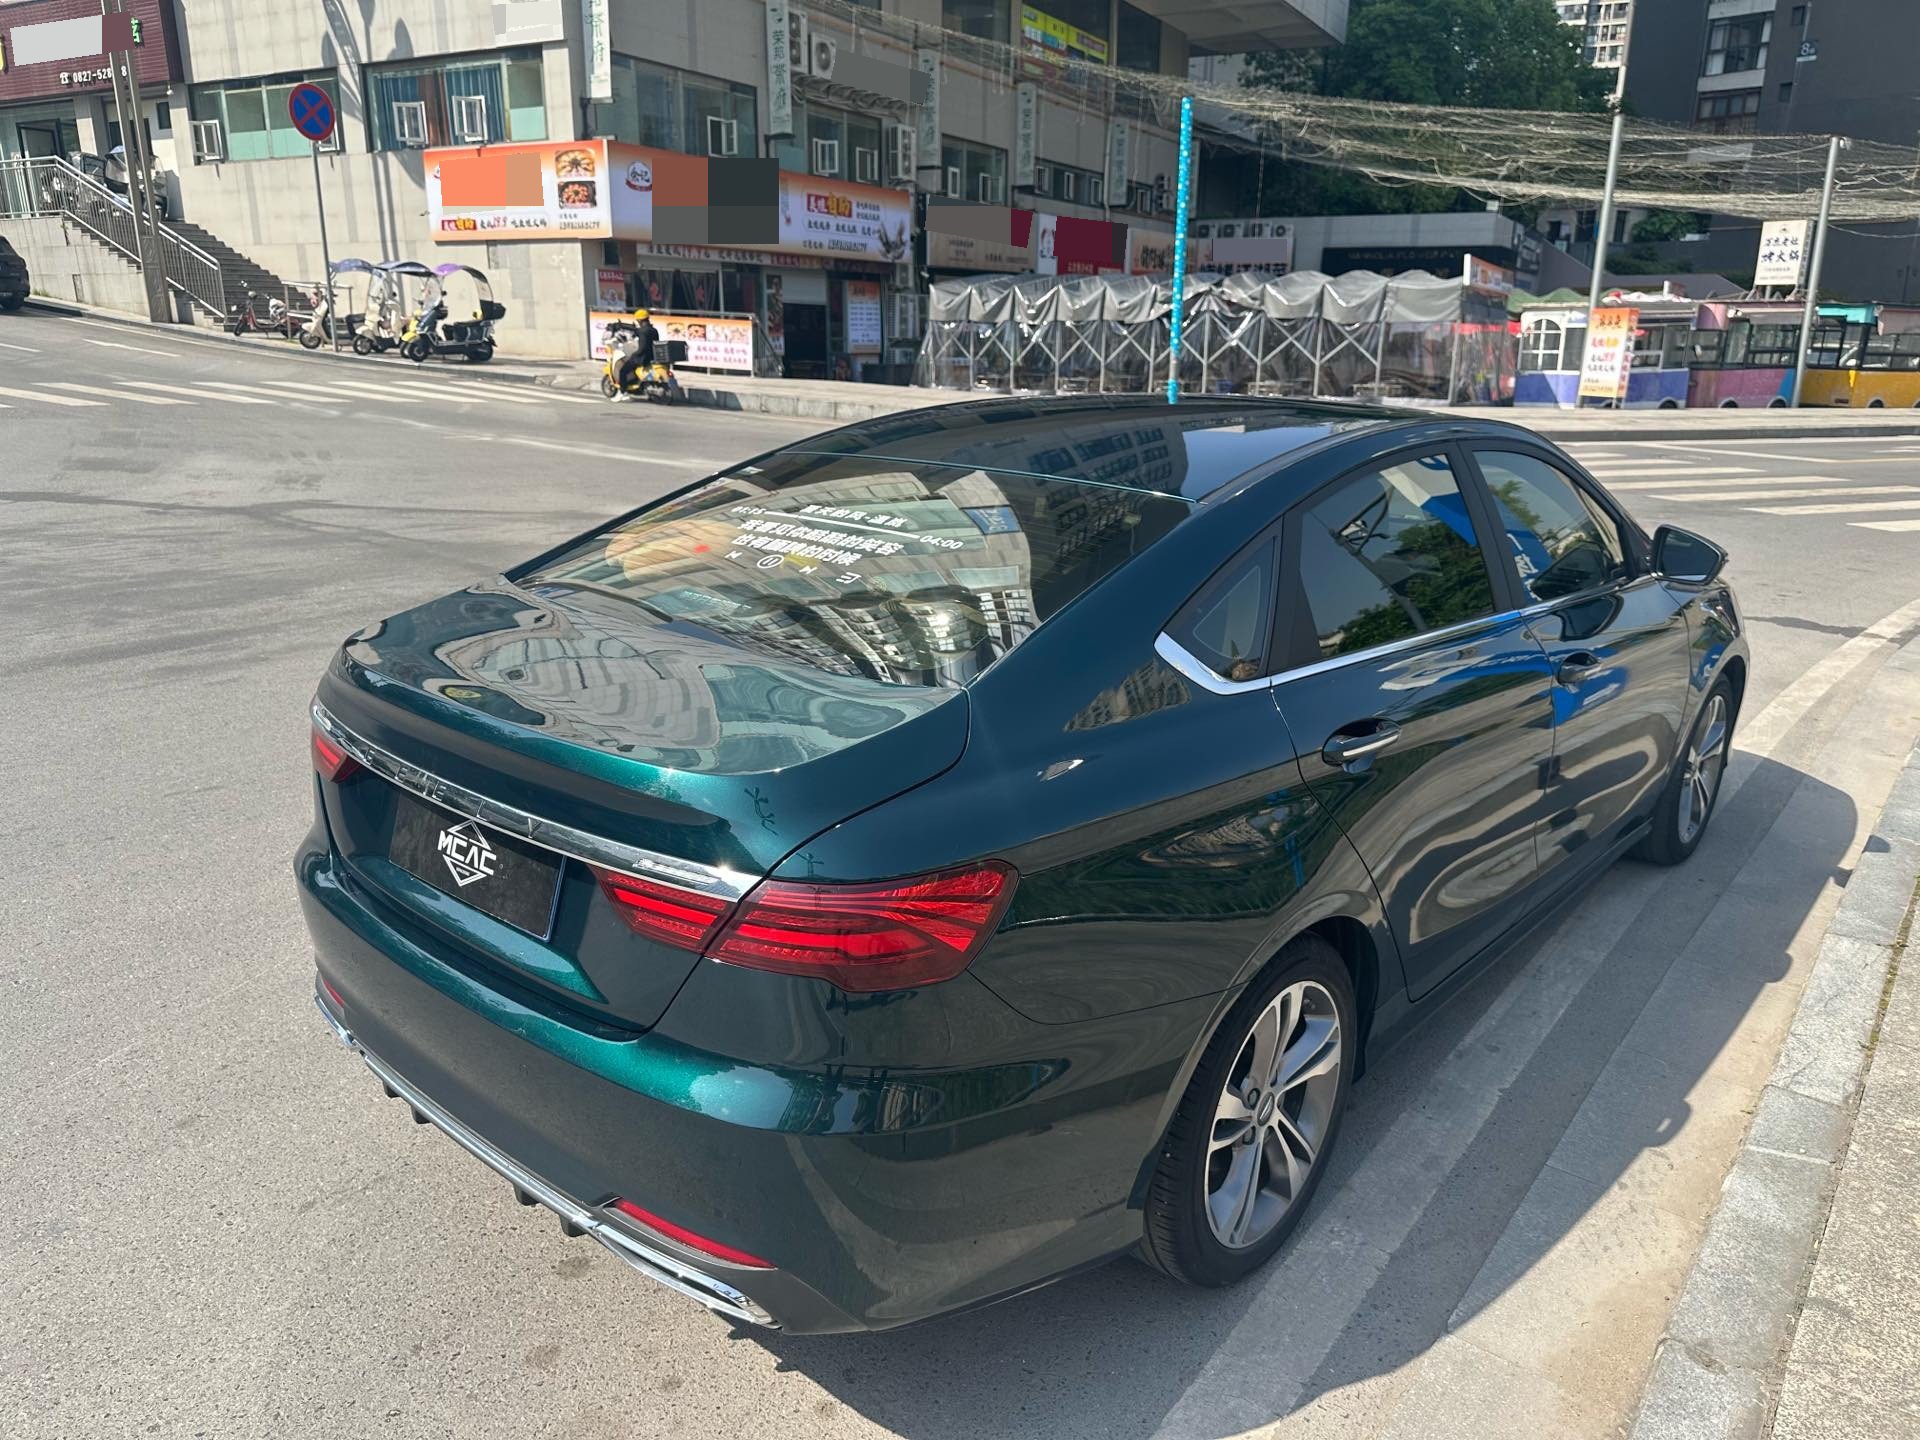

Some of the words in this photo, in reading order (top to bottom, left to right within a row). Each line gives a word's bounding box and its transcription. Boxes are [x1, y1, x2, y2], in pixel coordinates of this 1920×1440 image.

[919, 535, 963, 550] 04:00
[363, 748, 544, 839] GEELY
[437, 830, 497, 876] MCAC
